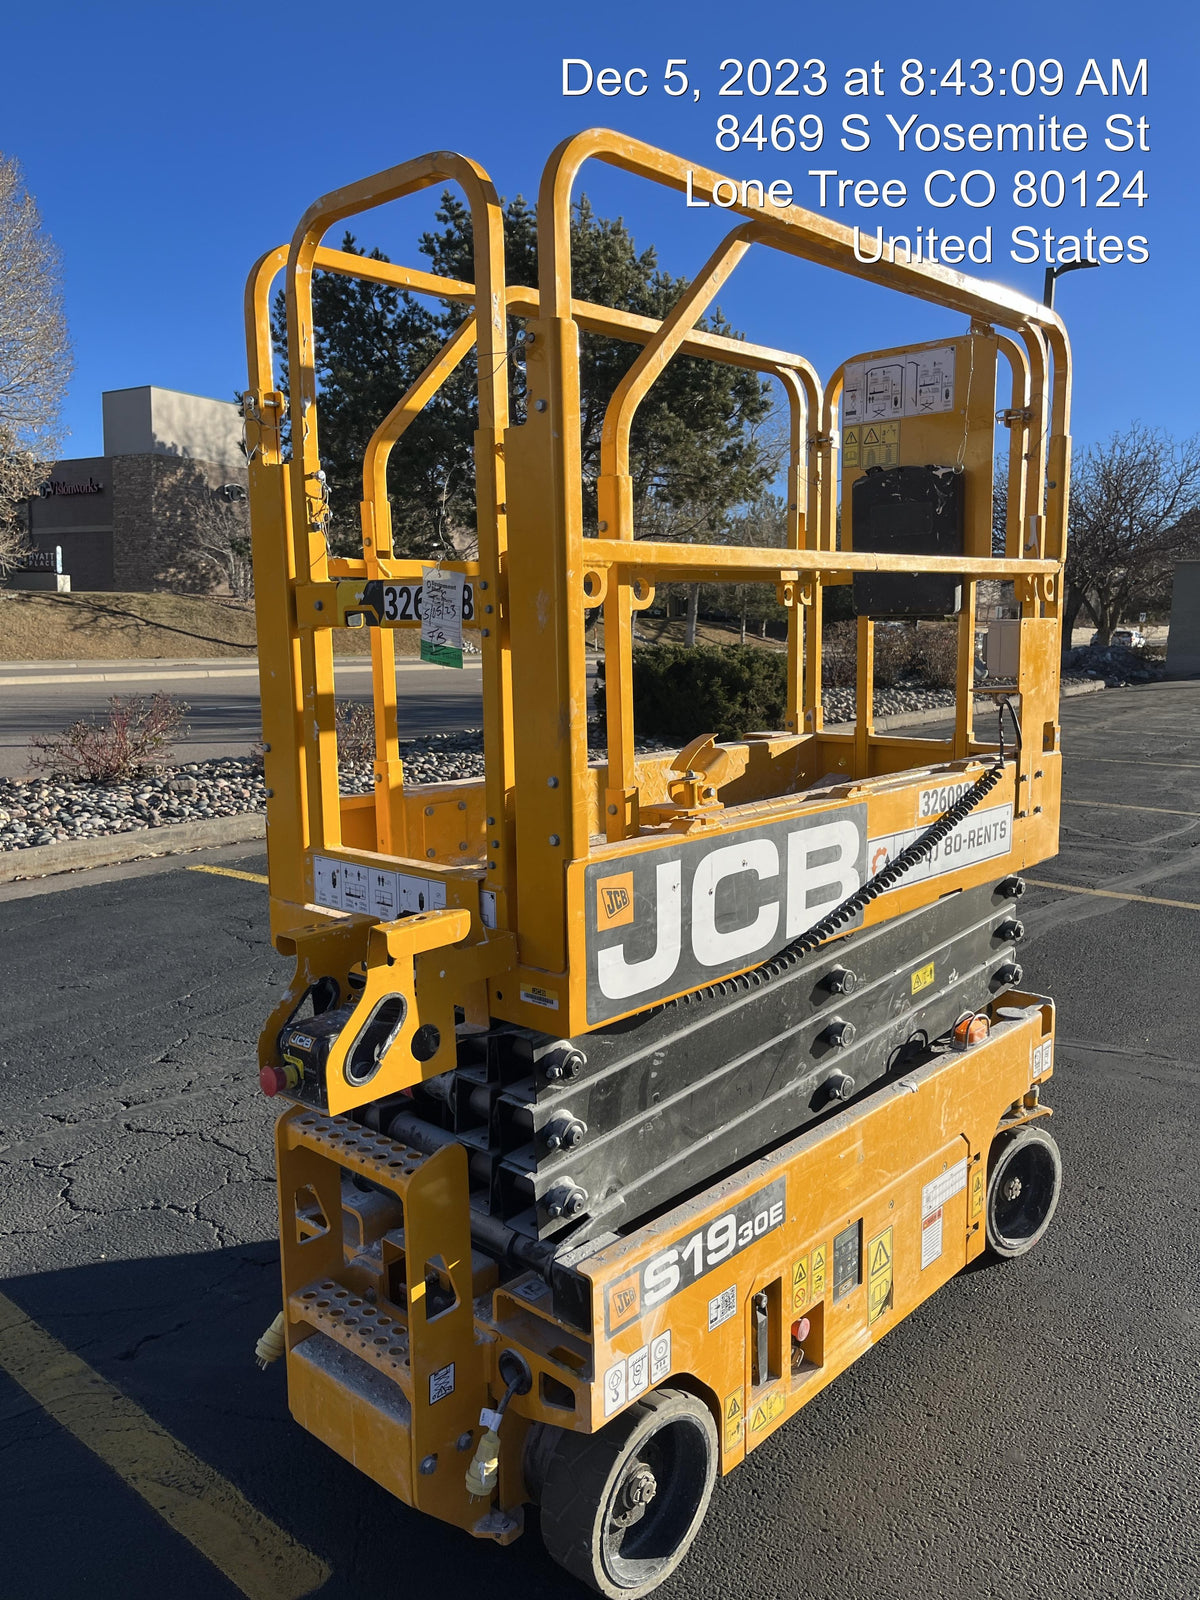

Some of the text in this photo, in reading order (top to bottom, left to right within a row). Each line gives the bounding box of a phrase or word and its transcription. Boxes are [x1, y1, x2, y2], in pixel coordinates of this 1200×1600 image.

[29, 552, 55, 561] HYATT
[384, 584, 474, 621] 3268
[944, 820, 1007, 856] 80-RENTS
[597, 820, 861, 1000] JCB
[605, 888, 629, 914] JCB
[290, 1034, 313, 1049] JCB
[616, 1287, 636, 1314] JCB
